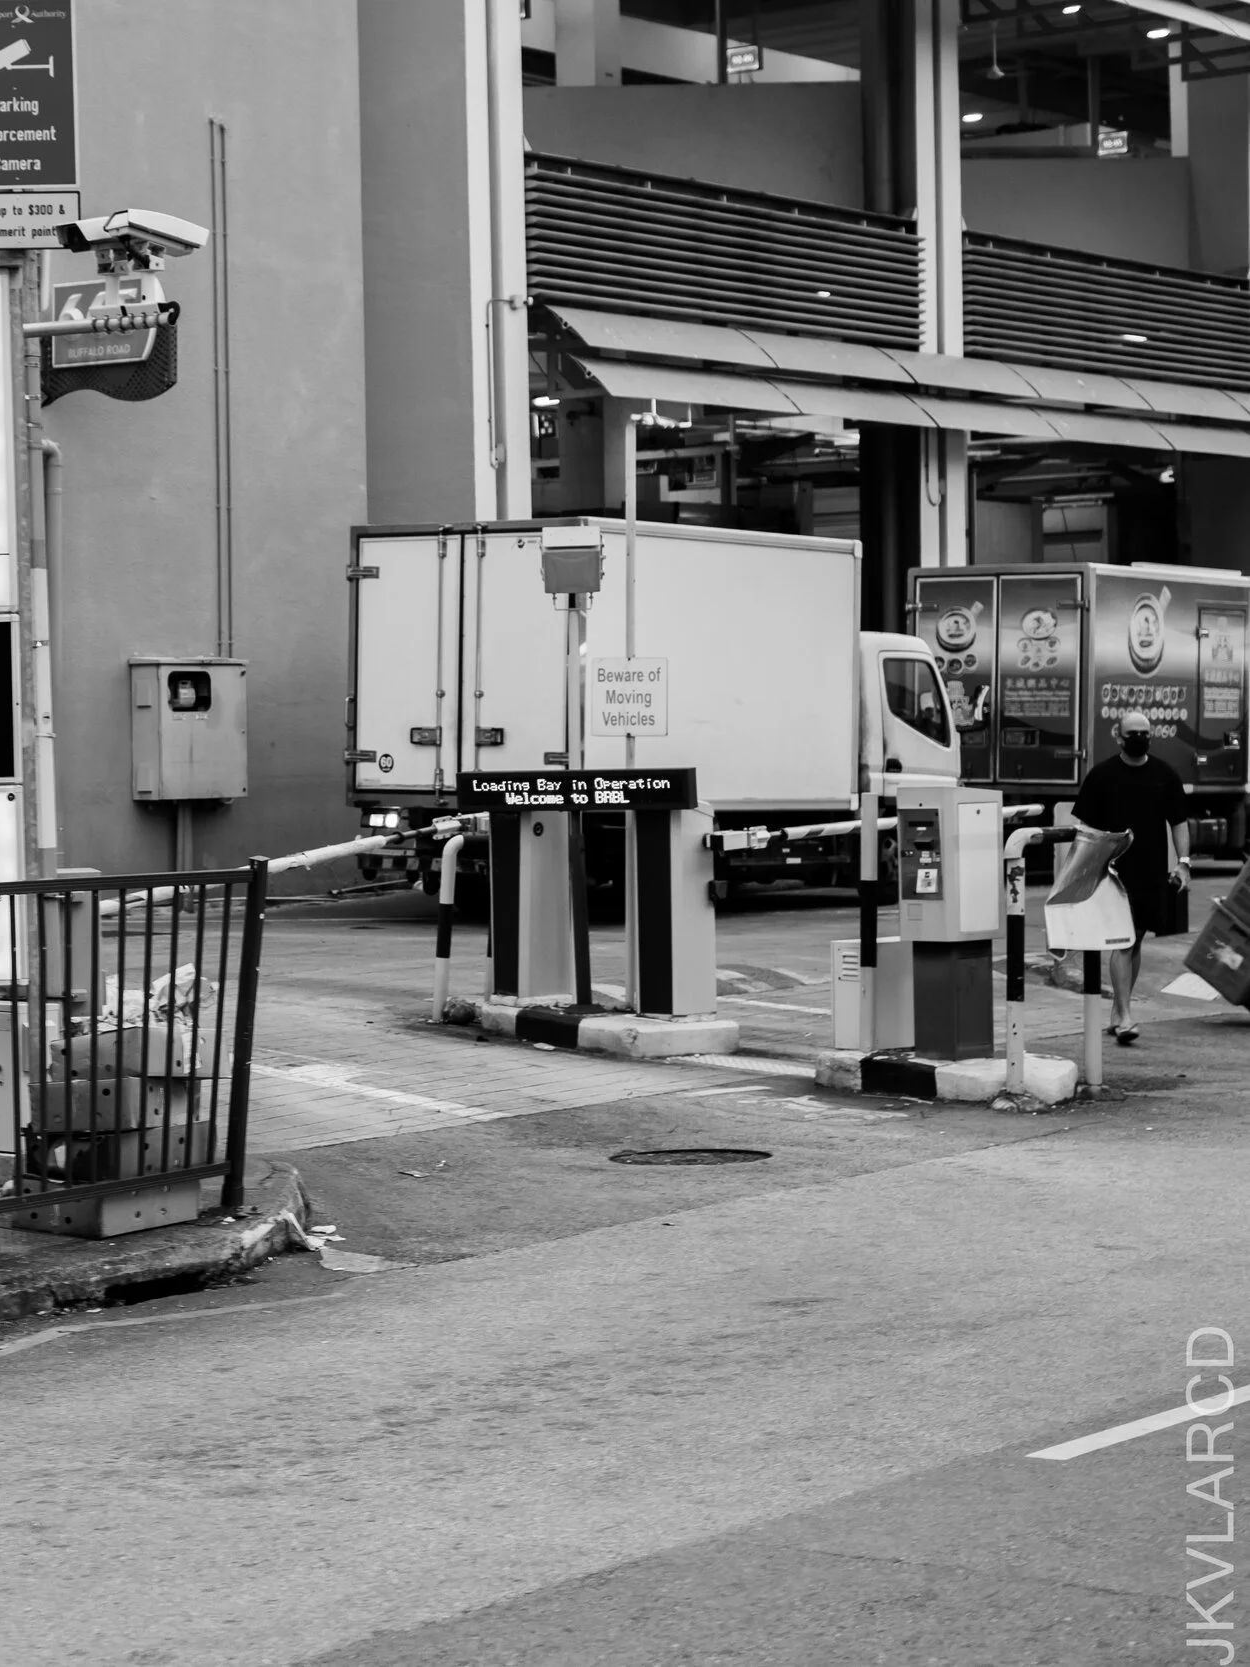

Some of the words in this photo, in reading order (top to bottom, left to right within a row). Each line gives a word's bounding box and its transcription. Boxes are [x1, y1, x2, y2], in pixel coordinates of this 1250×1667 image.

[13, 205, 23, 216] to
[28, 204, 53, 216] $300
[59, 204, 65, 215] &
[31, 225, 57, 239] point
[68, 346, 103, 358] BUFFALO
[106, 344, 131, 356] ROAD
[597, 667, 644, 682] Beware
[648, 667, 661, 682] of
[606, 689, 652, 708] Moving
[602, 711, 655, 726] Vehicles
[380, 756, 392, 767] 60
[473, 780, 530, 792] Loading
[537, 778, 562, 791] Bay
[572, 779, 587, 790] in
[594, 777, 671, 791] Operation
[505, 792, 564, 805] Welcome
[570, 792, 588, 804] to
